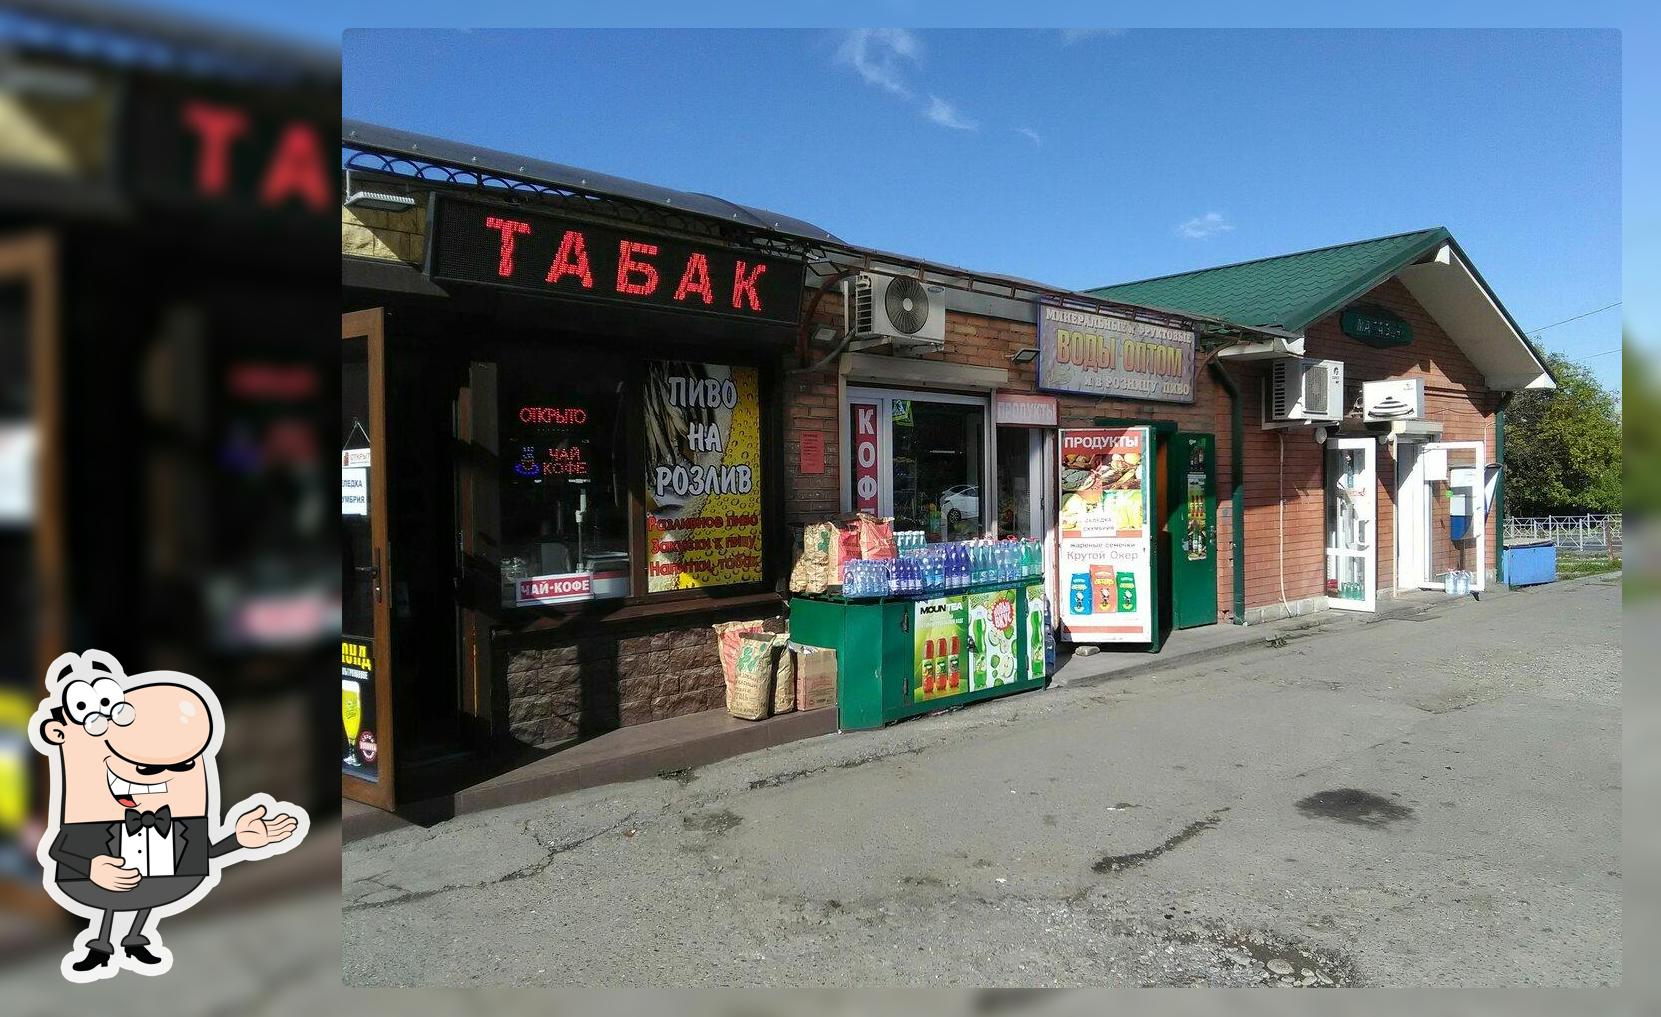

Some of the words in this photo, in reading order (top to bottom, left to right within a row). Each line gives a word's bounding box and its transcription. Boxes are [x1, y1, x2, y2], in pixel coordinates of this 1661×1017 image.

[486, 216, 767, 311] ТАБАК
[1046, 308, 1127, 331] МИНЕРАЛЬНЫЕ
[1056, 329, 1117, 373] ВОДЫ
[1122, 339, 1183, 378] ОПТОМ
[668, 376, 738, 409] ПИВО
[1163, 382, 1190, 396] ПИВО
[519, 407, 587, 424] ОТКРЫТО
[687, 421, 723, 453] НА
[1064, 434, 1139, 450] ПРОДУКТЫ
[548, 446, 581, 461] ЧАЙ
[857, 408, 878, 514] КОФ
[542, 461, 587, 475] КОФЕ
[655, 464, 753, 498] РОЗЛИВ
[647, 515, 724, 532] Разливное
[726, 514, 759, 527] пиво
[1067, 549, 1106, 562] Крутой
[1110, 550, 1139, 561] Окер
[520, 579, 590, 596] ЧАЙ-КОФЕ
